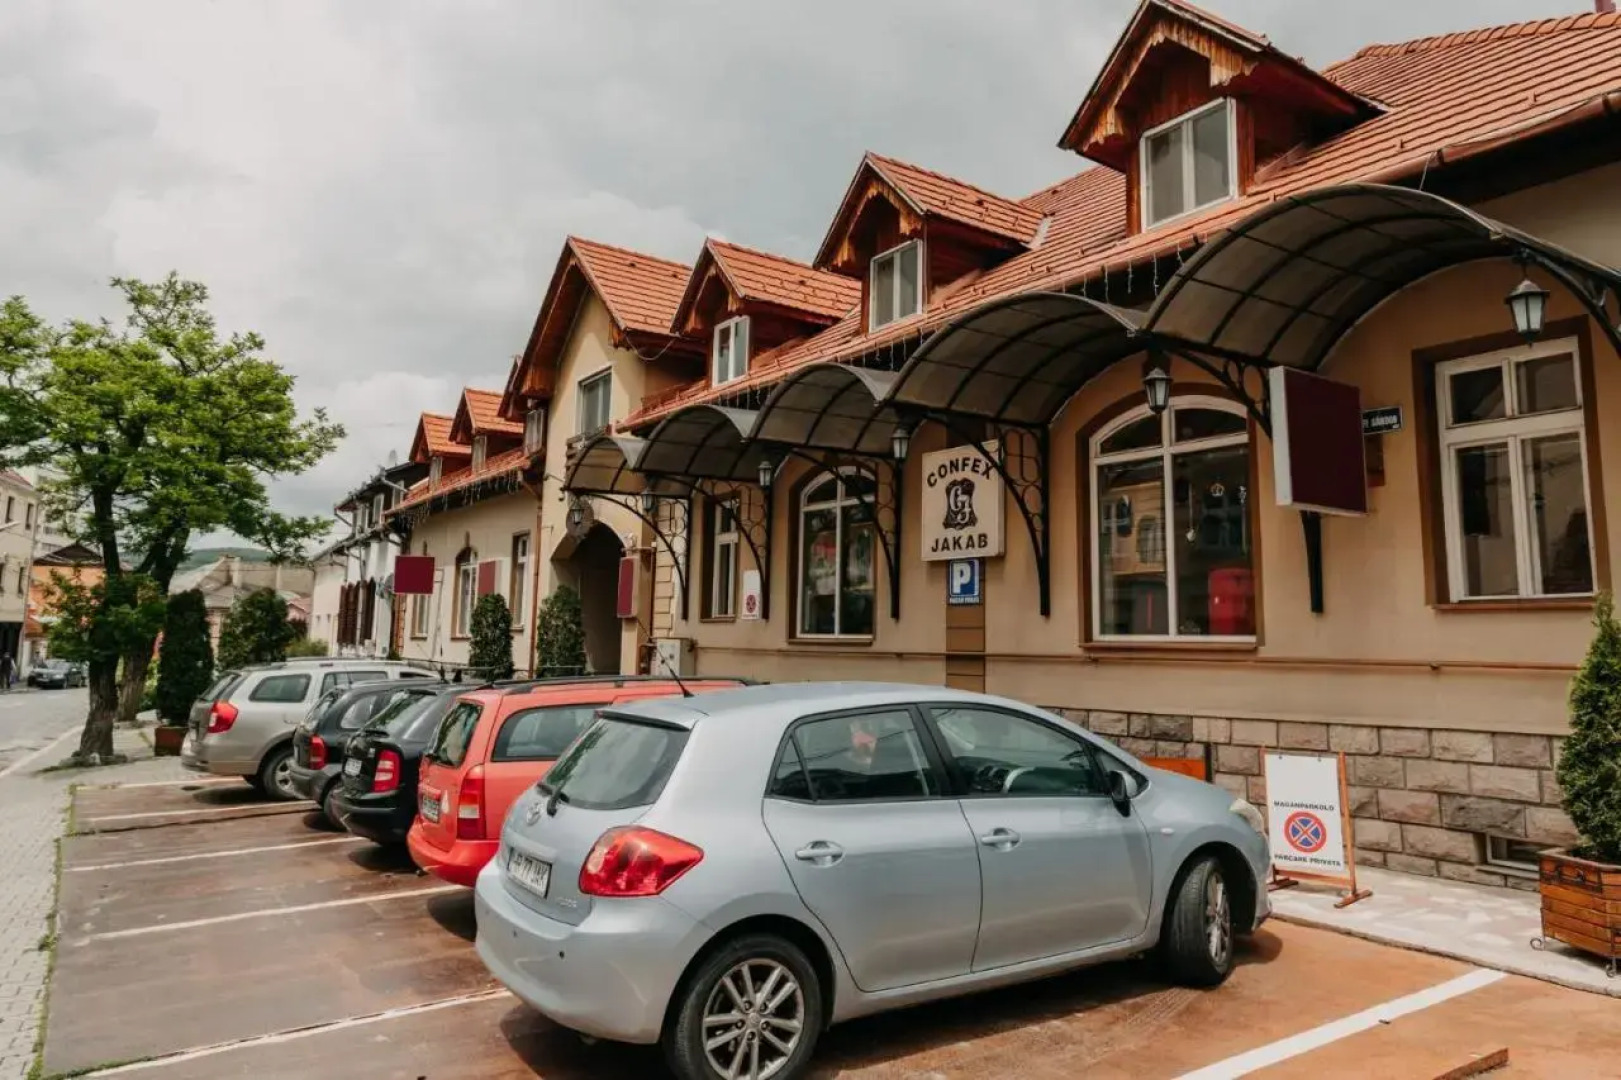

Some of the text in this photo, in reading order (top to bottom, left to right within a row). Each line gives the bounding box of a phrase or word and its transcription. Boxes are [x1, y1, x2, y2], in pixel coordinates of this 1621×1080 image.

[927, 457, 993, 488] CONFEX
[931, 533, 988, 552] JAKAB
[952, 562, 971, 594] P
